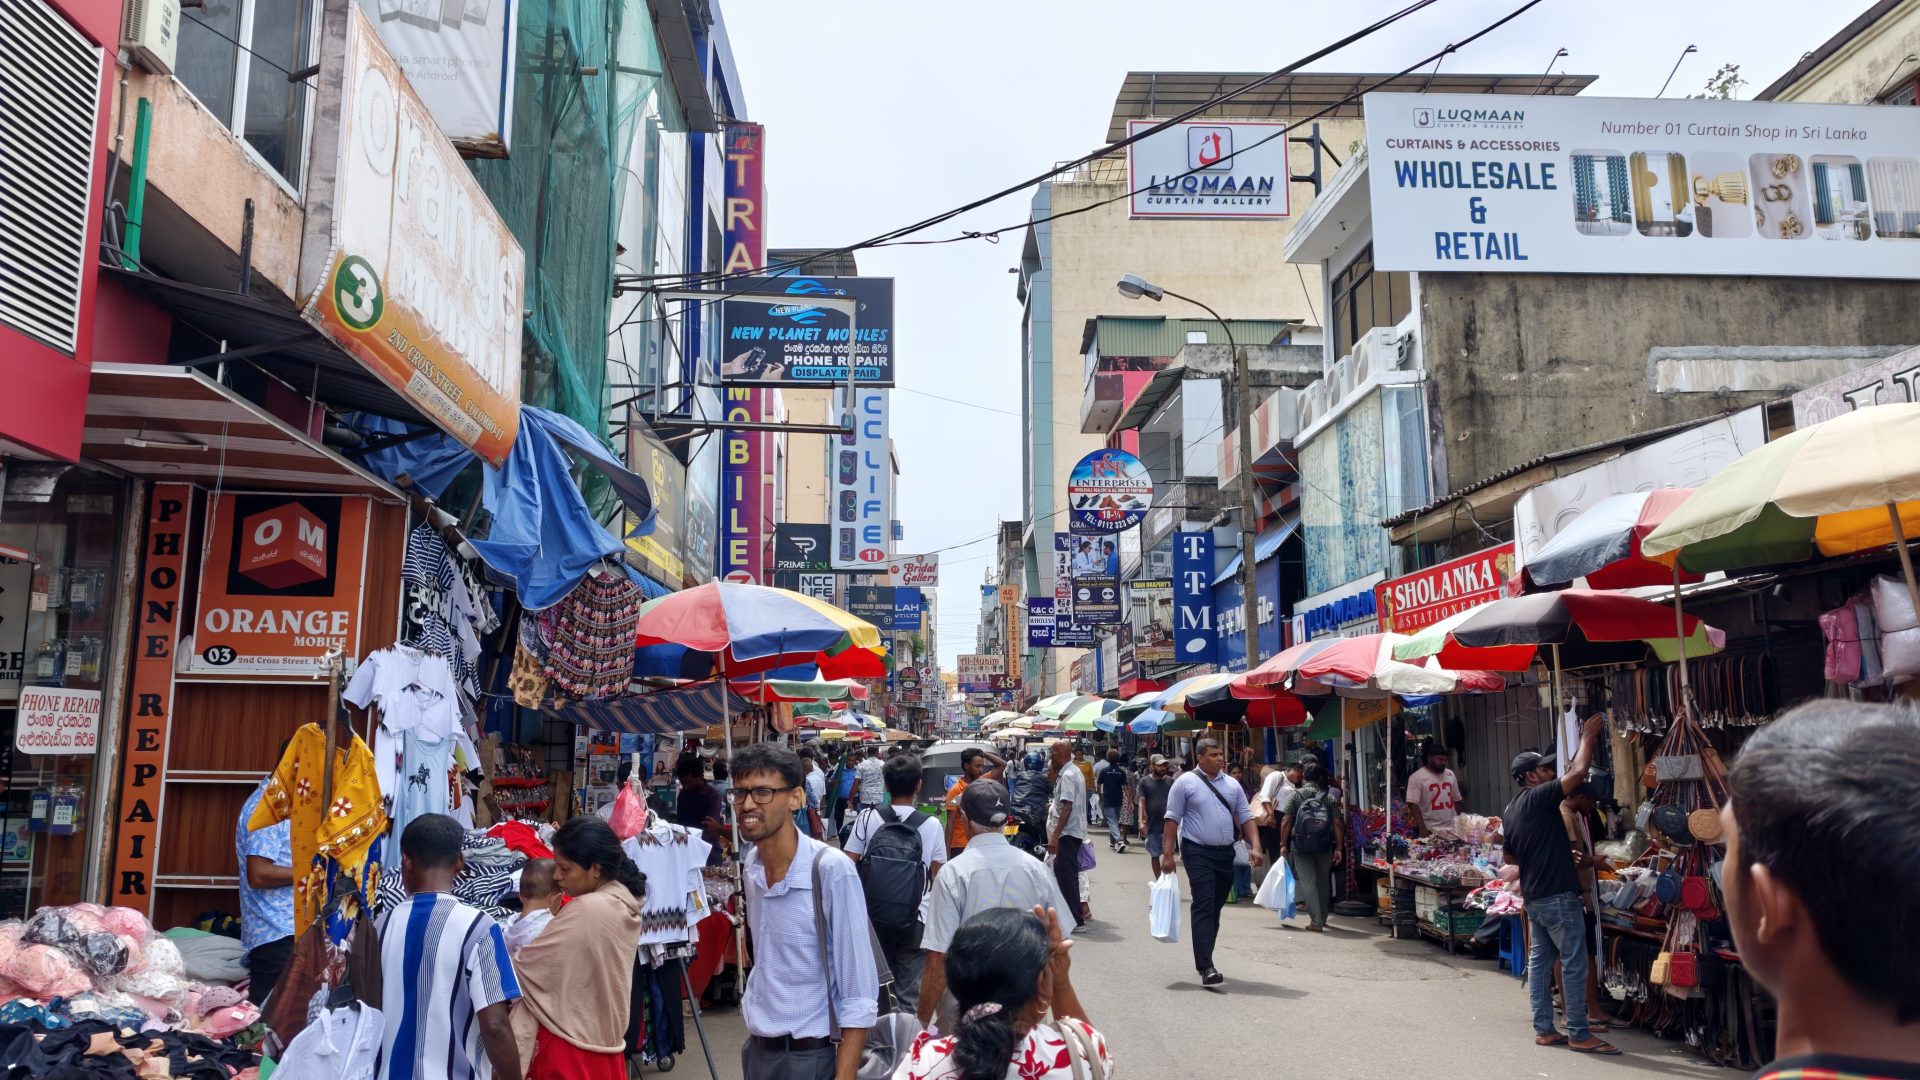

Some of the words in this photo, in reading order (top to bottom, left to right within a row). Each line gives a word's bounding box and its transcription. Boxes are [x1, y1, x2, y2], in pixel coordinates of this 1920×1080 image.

[411, 55, 491, 68] smartphones
[416, 71, 458, 81] Android
[1438, 109, 1525, 122] LUQMAAN
[1601, 120, 1660, 135] Number
[1665, 122, 1682, 136] 01
[1687, 122, 1740, 137] Curtain
[1744, 124, 1781, 142] Shop
[1784, 125, 1798, 139] in
[1802, 126, 1821, 140] Sri
[1825, 126, 1868, 141] Lanka
[1386, 138, 1453, 150] CURTAINS
[1457, 139, 1467, 150] &
[1469, 139, 1560, 152] ACCESSORIES
[1394, 159, 1557, 190] WHOLESALE
[1149, 175, 1275, 194] LUQMAAN
[359, 66, 517, 332] Orange
[1469, 196, 1487, 224] &
[1434, 231, 1528, 261] RETAIL
[341, 262, 378, 323] 3
[731, 326, 764, 340] NEW
[769, 327, 822, 341] PLANET
[386, 328, 408, 353] 2ND
[407, 345, 436, 378] CROSS
[784, 355, 833, 366] PHONE
[837, 356, 888, 367] RPAIR
[795, 369, 837, 377] DISPLAY
[1090, 452, 1130, 478] R&R
[1076, 479, 1147, 487] ENTERPRISES
[863, 450, 882, 544] LIFE
[1084, 511, 1097, 525] TEL:
[1097, 520, 1114, 529] 0112
[1114, 519, 1127, 529] 323
[1126, 513, 1140, 525] 696
[254, 518, 283, 546] O
[298, 517, 324, 551] M
[866, 550, 878, 560] 11
[903, 562, 937, 573] Bridal
[145, 499, 182, 659] PHONE
[801, 576, 833, 587] NCC
[902, 573, 938, 586] Gallery
[1395, 558, 1496, 612] SHOLANKA
[895, 604, 919, 612] LAH
[1305, 588, 1377, 641] LUQMAAN
[204, 608, 350, 635] ORANGE
[1058, 620, 1070, 628] NO
[293, 636, 347, 648] MOBILE
[208, 649, 231, 663] 03
[238, 657, 254, 665] 2nd
[257, 657, 280, 665] Cross
[997, 677, 1016, 688] 48
[22, 693, 62, 711] PHONE
[63, 696, 100, 713] REPAIR
[119, 693, 164, 896] REPAIR
[1429, 783, 1455, 811] 23
